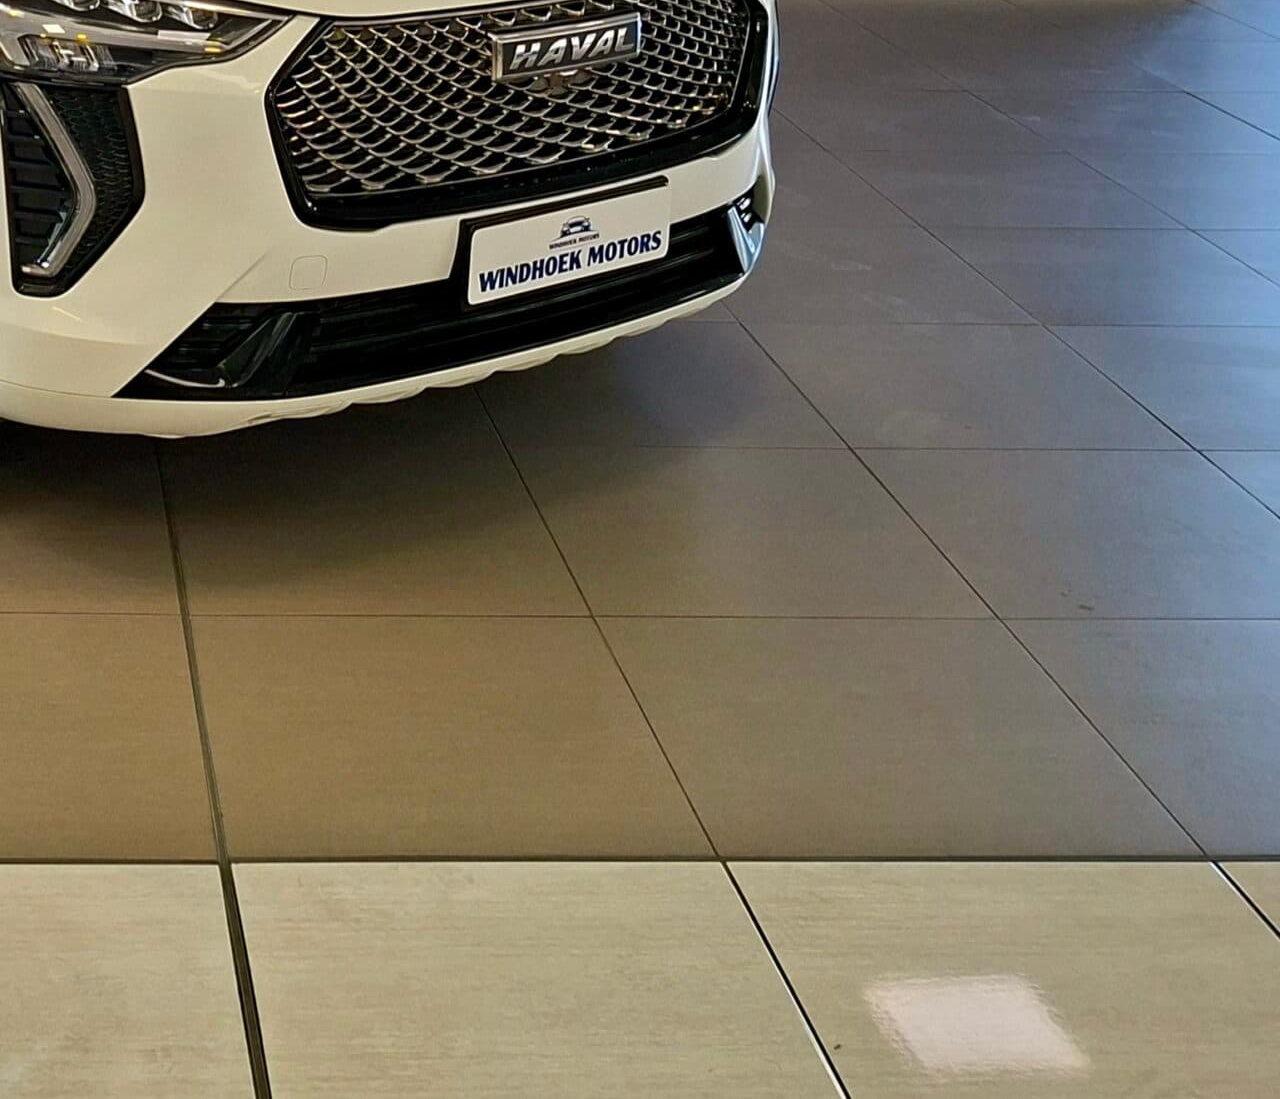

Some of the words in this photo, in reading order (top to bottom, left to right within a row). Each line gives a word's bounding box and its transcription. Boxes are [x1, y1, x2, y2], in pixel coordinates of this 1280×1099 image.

[509, 27, 634, 70] HAVAL
[478, 249, 582, 293] WINDHOEK
[587, 229, 662, 267] MOTORS
